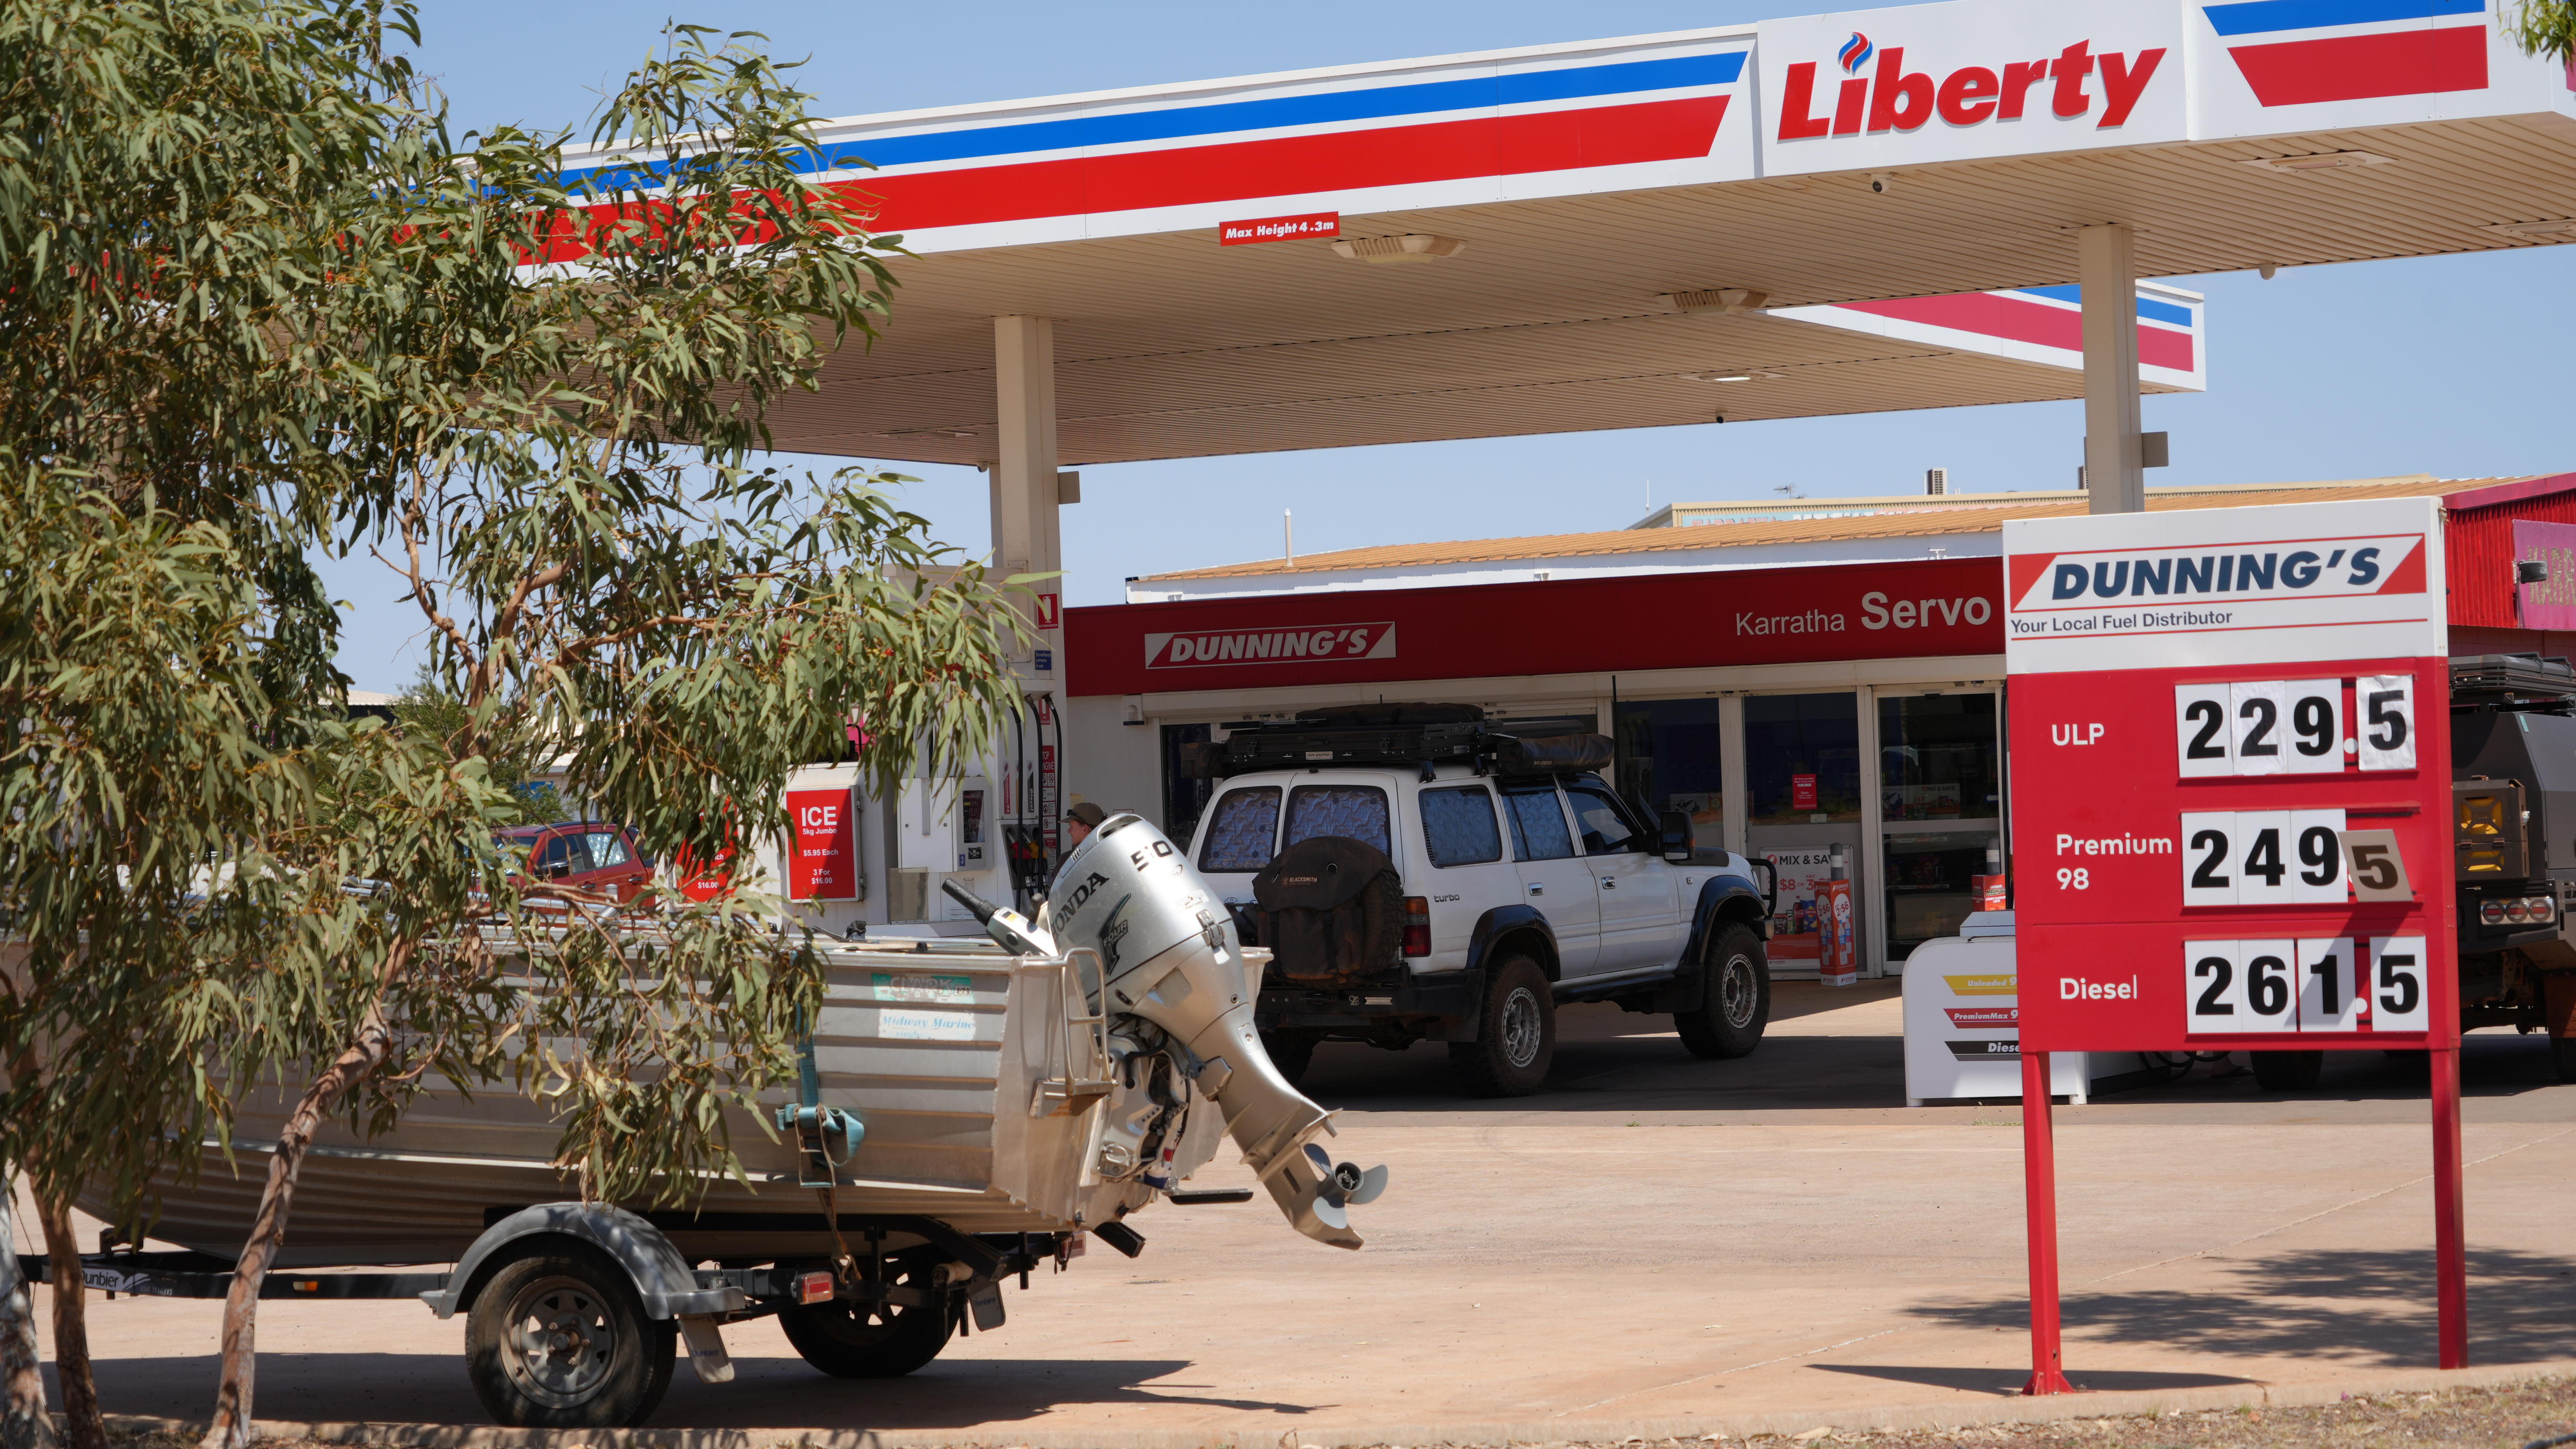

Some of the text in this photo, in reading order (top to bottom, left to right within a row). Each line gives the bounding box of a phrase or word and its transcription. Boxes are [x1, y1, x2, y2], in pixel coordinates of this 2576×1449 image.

[1777, 32, 2167, 141] Liberty
[1225, 228, 1252, 239] Max
[1257, 223, 1297, 237] Height
[2052, 547, 2381, 601] DUNNING'S
[1736, 591, 1991, 636] Karratha Servo
[2011, 610, 2233, 634] Your Local Fuel Distributor
[1170, 628, 1368, 662] DUNNING'S
[2051, 689, 2407, 760] ULP 229.5
[1042, 761, 1054, 771] NGINE
[801, 806, 837, 827] ICE
[2056, 832, 2172, 856] Premium
[960, 856, 964, 864] 3
[1780, 855, 1831, 865] MIX & SA
[1780, 879, 1796, 892] $8
[2056, 868, 2089, 891] 98
[1051, 872, 1110, 942] HONDA
[1433, 894, 1460, 902] turbo
[1104, 921, 1128, 947] FOUR
[889, 976, 953, 995] CLARK
[2009, 976, 2018, 986] 9
[2060, 953, 2418, 1016] Diesel 261.5
[883, 1015, 975, 1029] Midway Marine
[2010, 1009, 2019, 1019] 9
[1988, 1042, 2020, 1053] Diese
